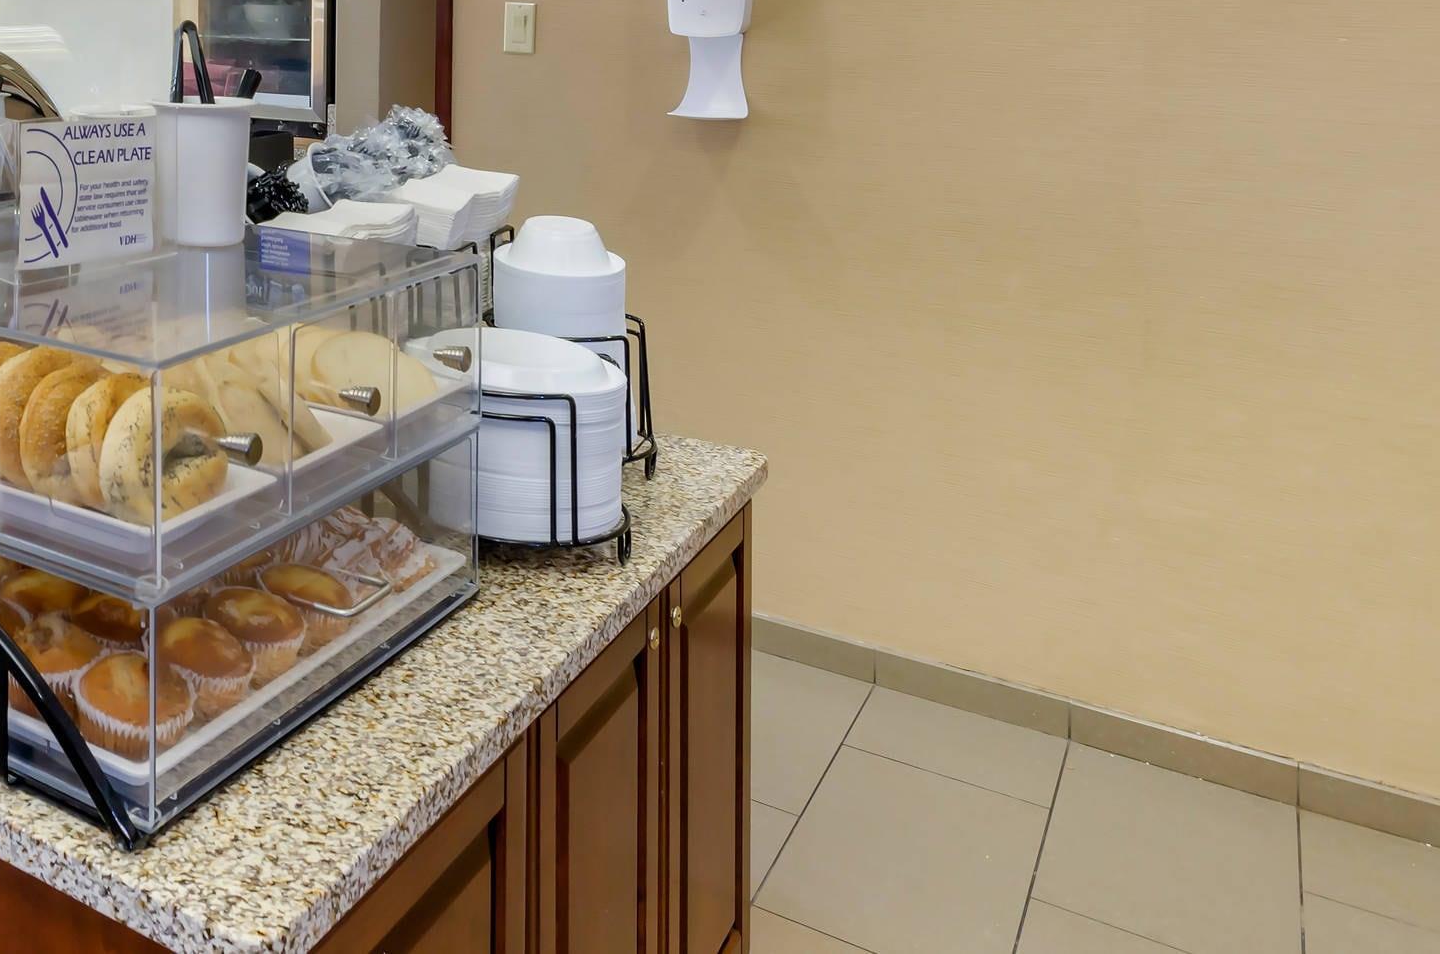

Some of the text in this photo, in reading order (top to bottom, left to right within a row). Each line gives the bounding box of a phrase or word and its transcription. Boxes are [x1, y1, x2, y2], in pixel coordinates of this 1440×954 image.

[63, 122, 146, 140] ALWAYS USE A
[73, 147, 152, 165] CLEAN PLATE
[90, 183, 101, 192] your
[104, 191, 125, 199] requires
[97, 201, 124, 209] consumers
[80, 223, 108, 232] additional
[120, 234, 137, 246] VDH
